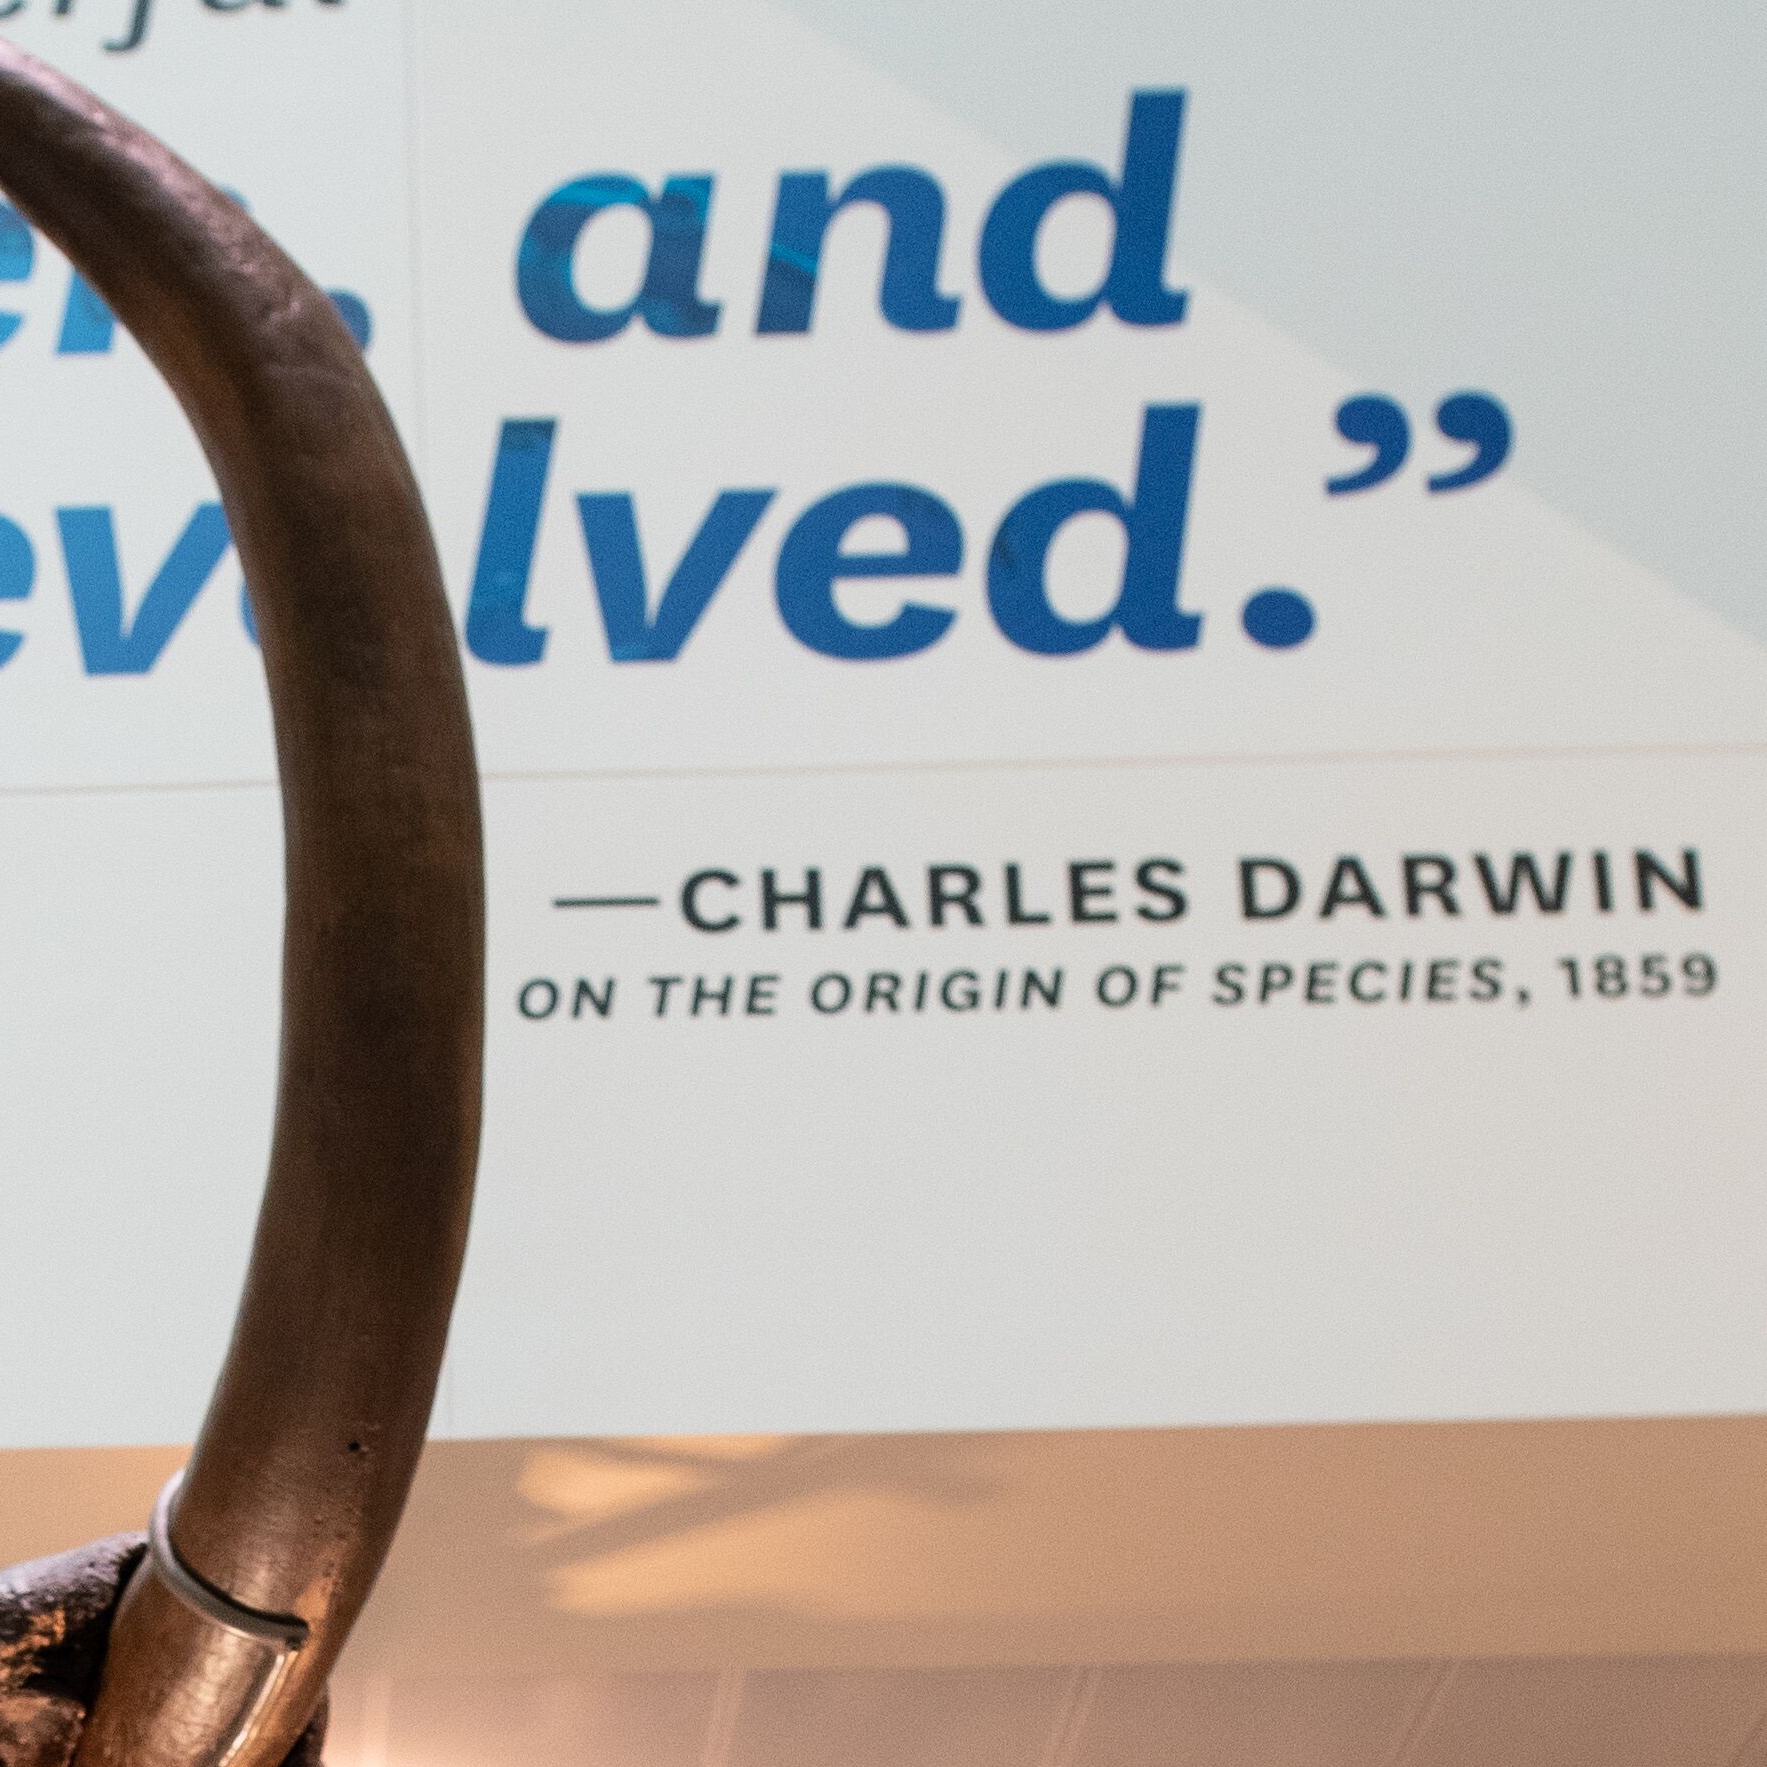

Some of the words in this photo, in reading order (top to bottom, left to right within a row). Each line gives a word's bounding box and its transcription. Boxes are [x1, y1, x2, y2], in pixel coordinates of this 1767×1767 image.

[512, 85, 1195, 346] and
[1235, 846, 1707, 922] DARWIN
[515, 975, 617, 1021] ON
[647, 972, 780, 1018] THE
[806, 966, 1065, 1016] ORIGIN
[1093, 963, 1183, 1009] OF
[1210, 957, 1530, 1008] SPECIES,
[1558, 951, 1719, 1000] 1859
